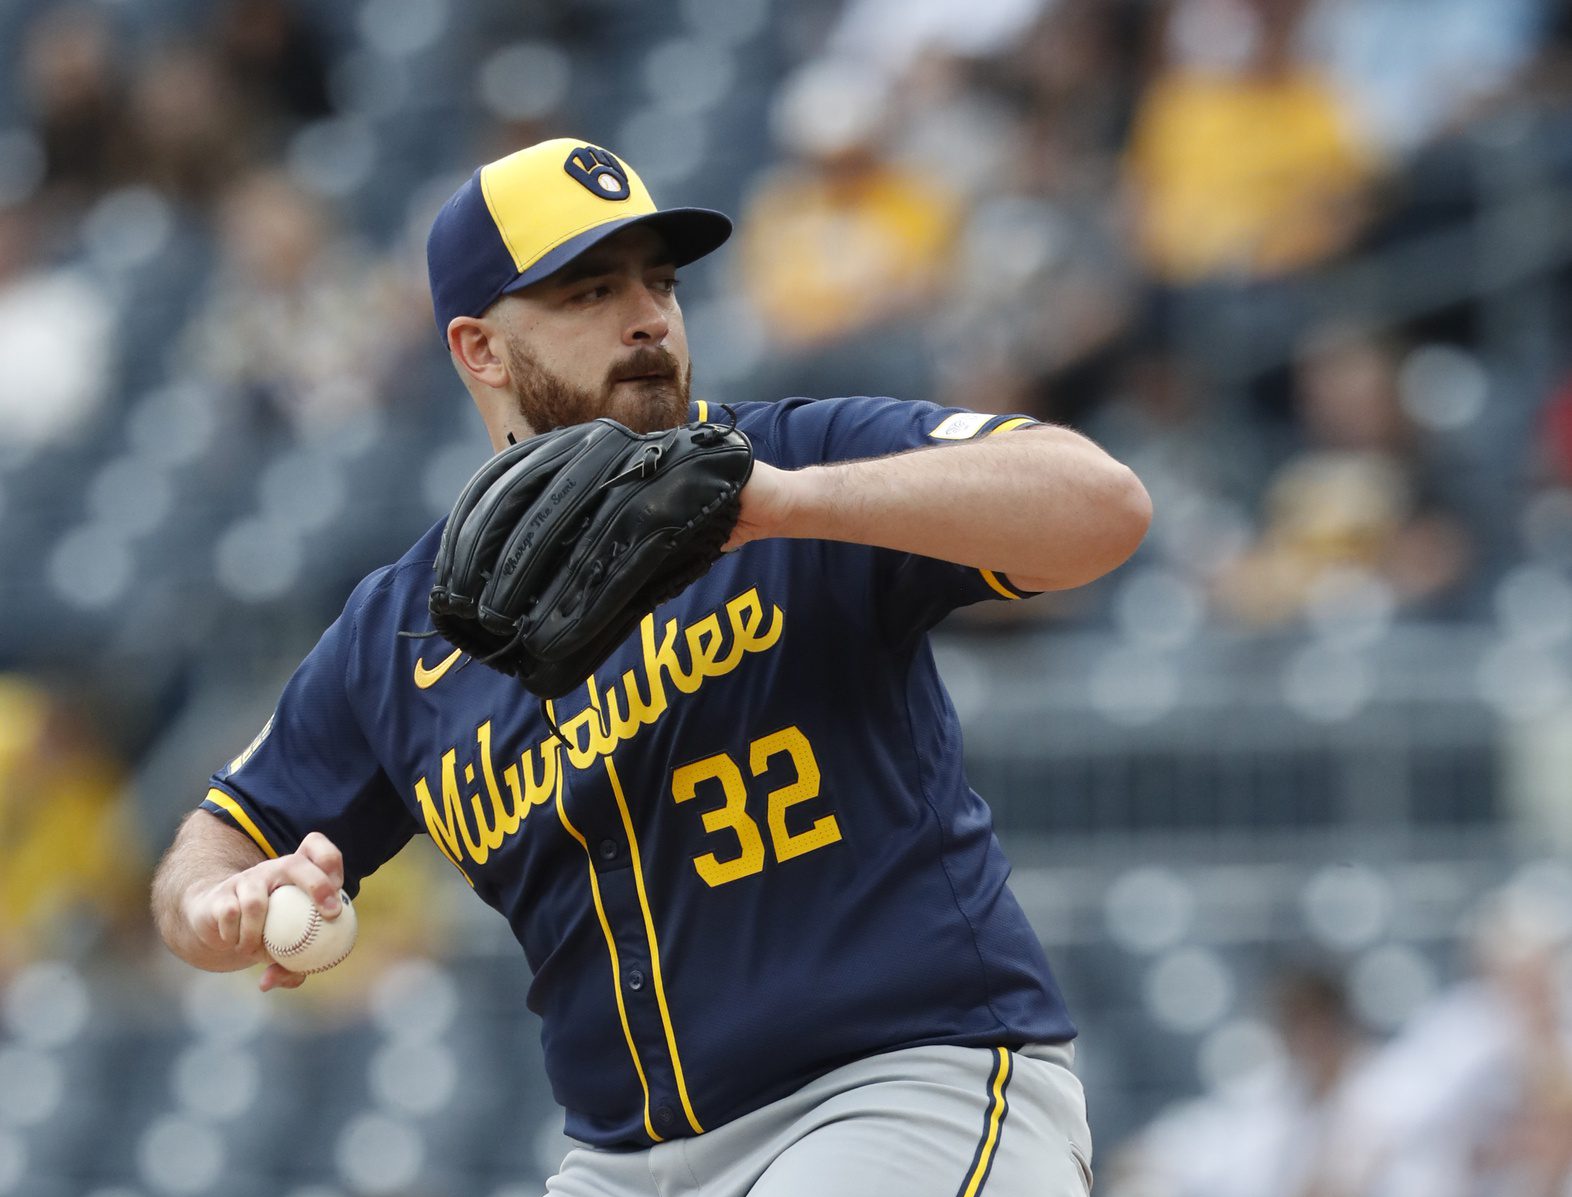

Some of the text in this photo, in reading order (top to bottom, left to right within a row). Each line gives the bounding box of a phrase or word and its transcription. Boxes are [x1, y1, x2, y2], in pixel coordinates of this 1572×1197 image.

[503, 478, 577, 576] Charge The Semi
[414, 587, 785, 888] Milwaukee
[671, 726, 843, 888] 32
